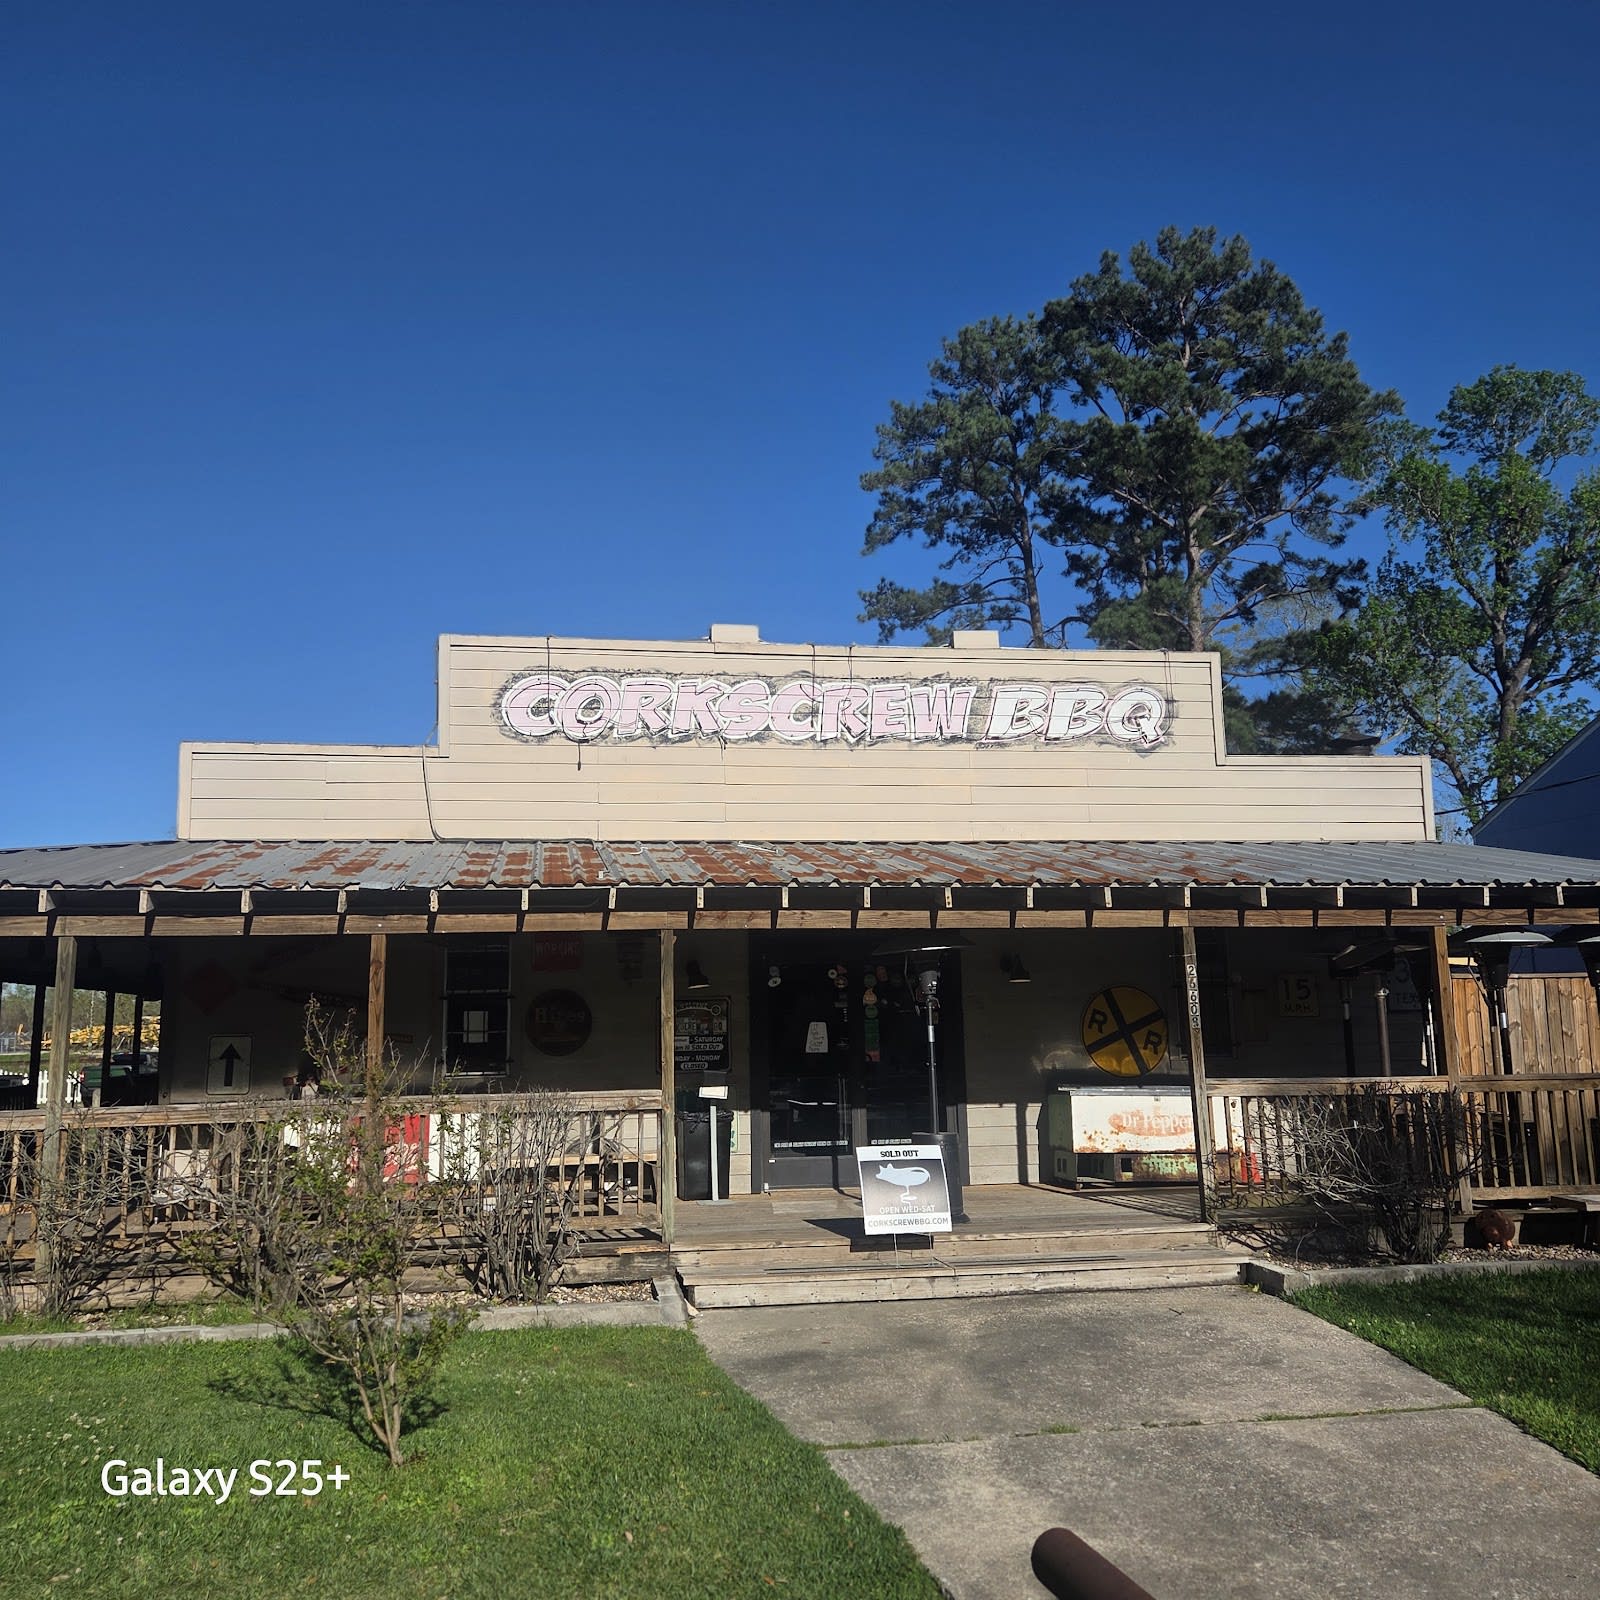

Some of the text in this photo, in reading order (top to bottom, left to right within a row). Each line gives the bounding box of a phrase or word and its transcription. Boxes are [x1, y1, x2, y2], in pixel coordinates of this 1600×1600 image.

[501, 675, 1166, 745] CORKSCREW BBQ
[1088, 1008, 1108, 1034] R
[1142, 1030, 1163, 1056] R
[695, 1054, 721, 1062] MONDAY
[880, 1149, 920, 1158] SOLD OUT
[879, 1204, 936, 1215] OPEN WED-SAT
[867, 1217, 949, 1228] CORKSCREWBBQ.COM
